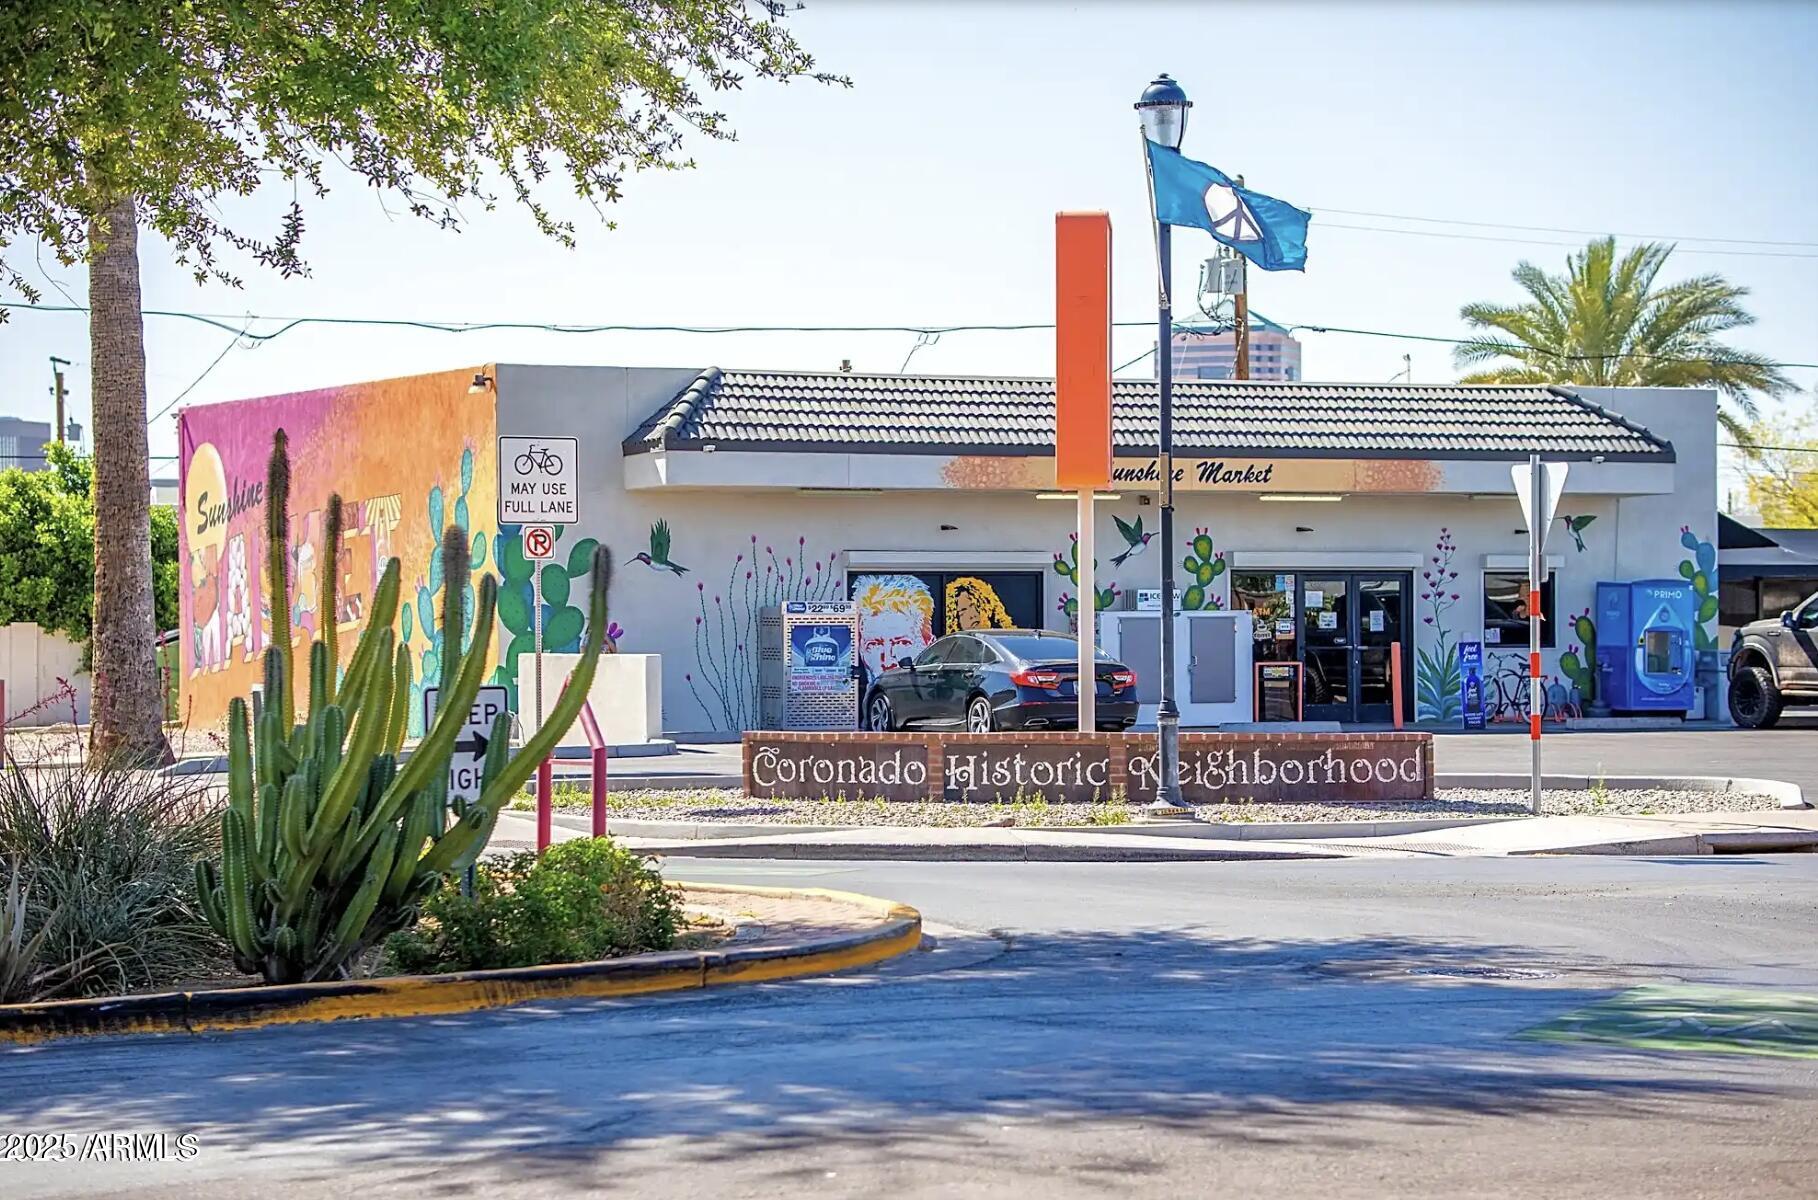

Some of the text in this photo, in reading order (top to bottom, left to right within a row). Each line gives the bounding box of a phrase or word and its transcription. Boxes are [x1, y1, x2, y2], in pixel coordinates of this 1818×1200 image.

[1196, 461, 1273, 484] Market
[511, 483, 567, 495] MAY USE
[197, 476, 264, 535] Sunshine
[504, 500, 573, 513] FULL LANE
[1654, 590, 1682, 599] PRIMO
[752, 746, 1424, 791] Coronado Historic Neighborhood
